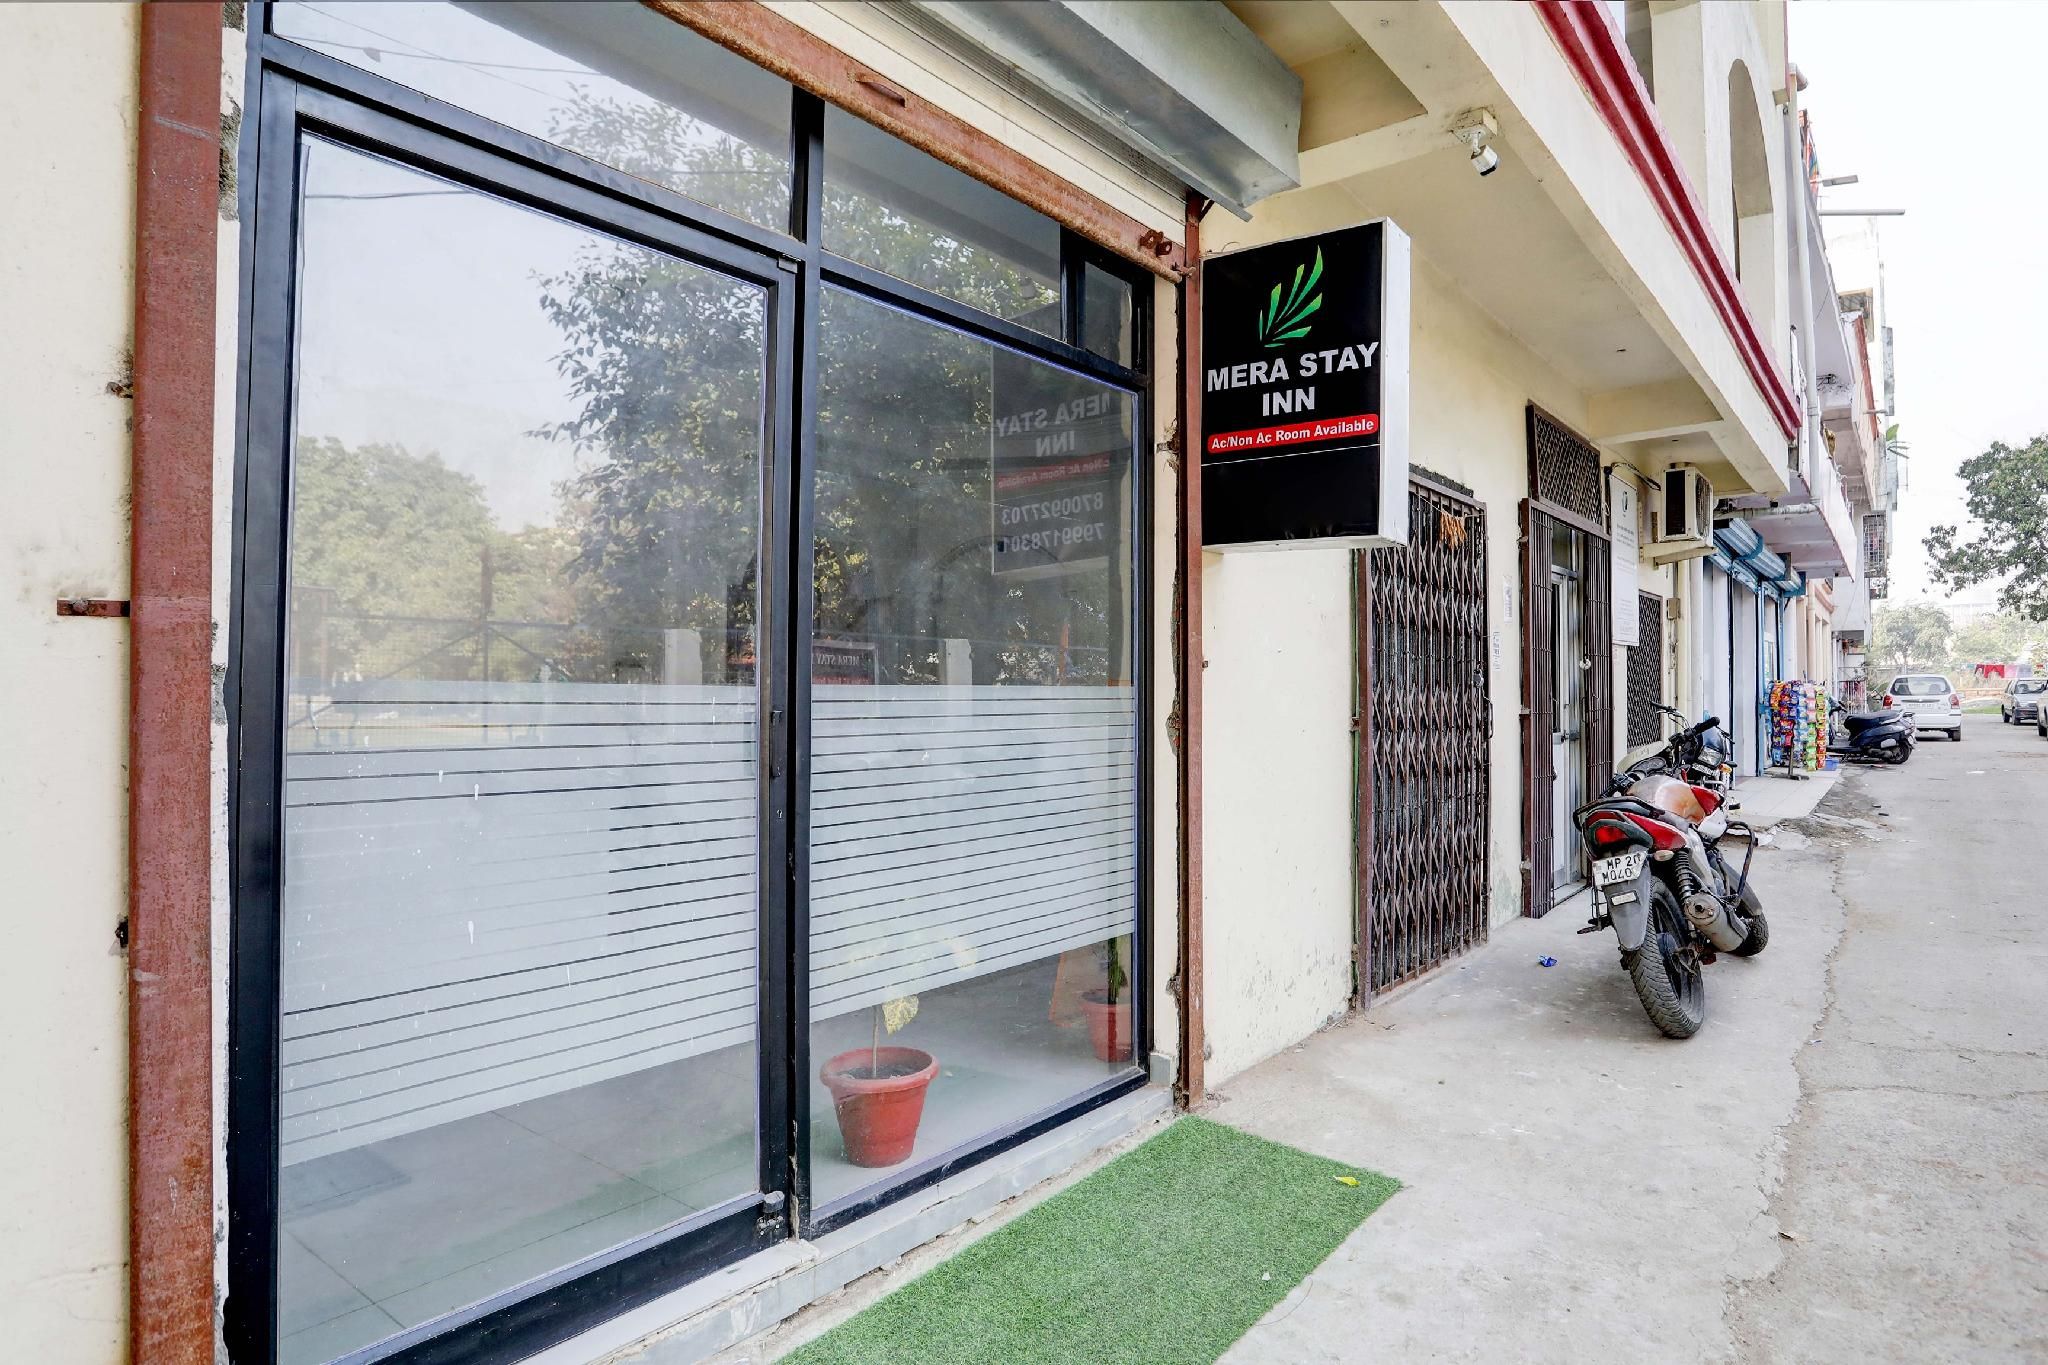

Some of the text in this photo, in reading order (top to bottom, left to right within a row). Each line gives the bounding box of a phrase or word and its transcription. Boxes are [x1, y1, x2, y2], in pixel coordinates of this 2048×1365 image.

[1207, 341, 1379, 393] MERA STAY
[1262, 386, 1316, 417] INN
[1211, 418, 1375, 450] Ac/Non Ac Room Available
